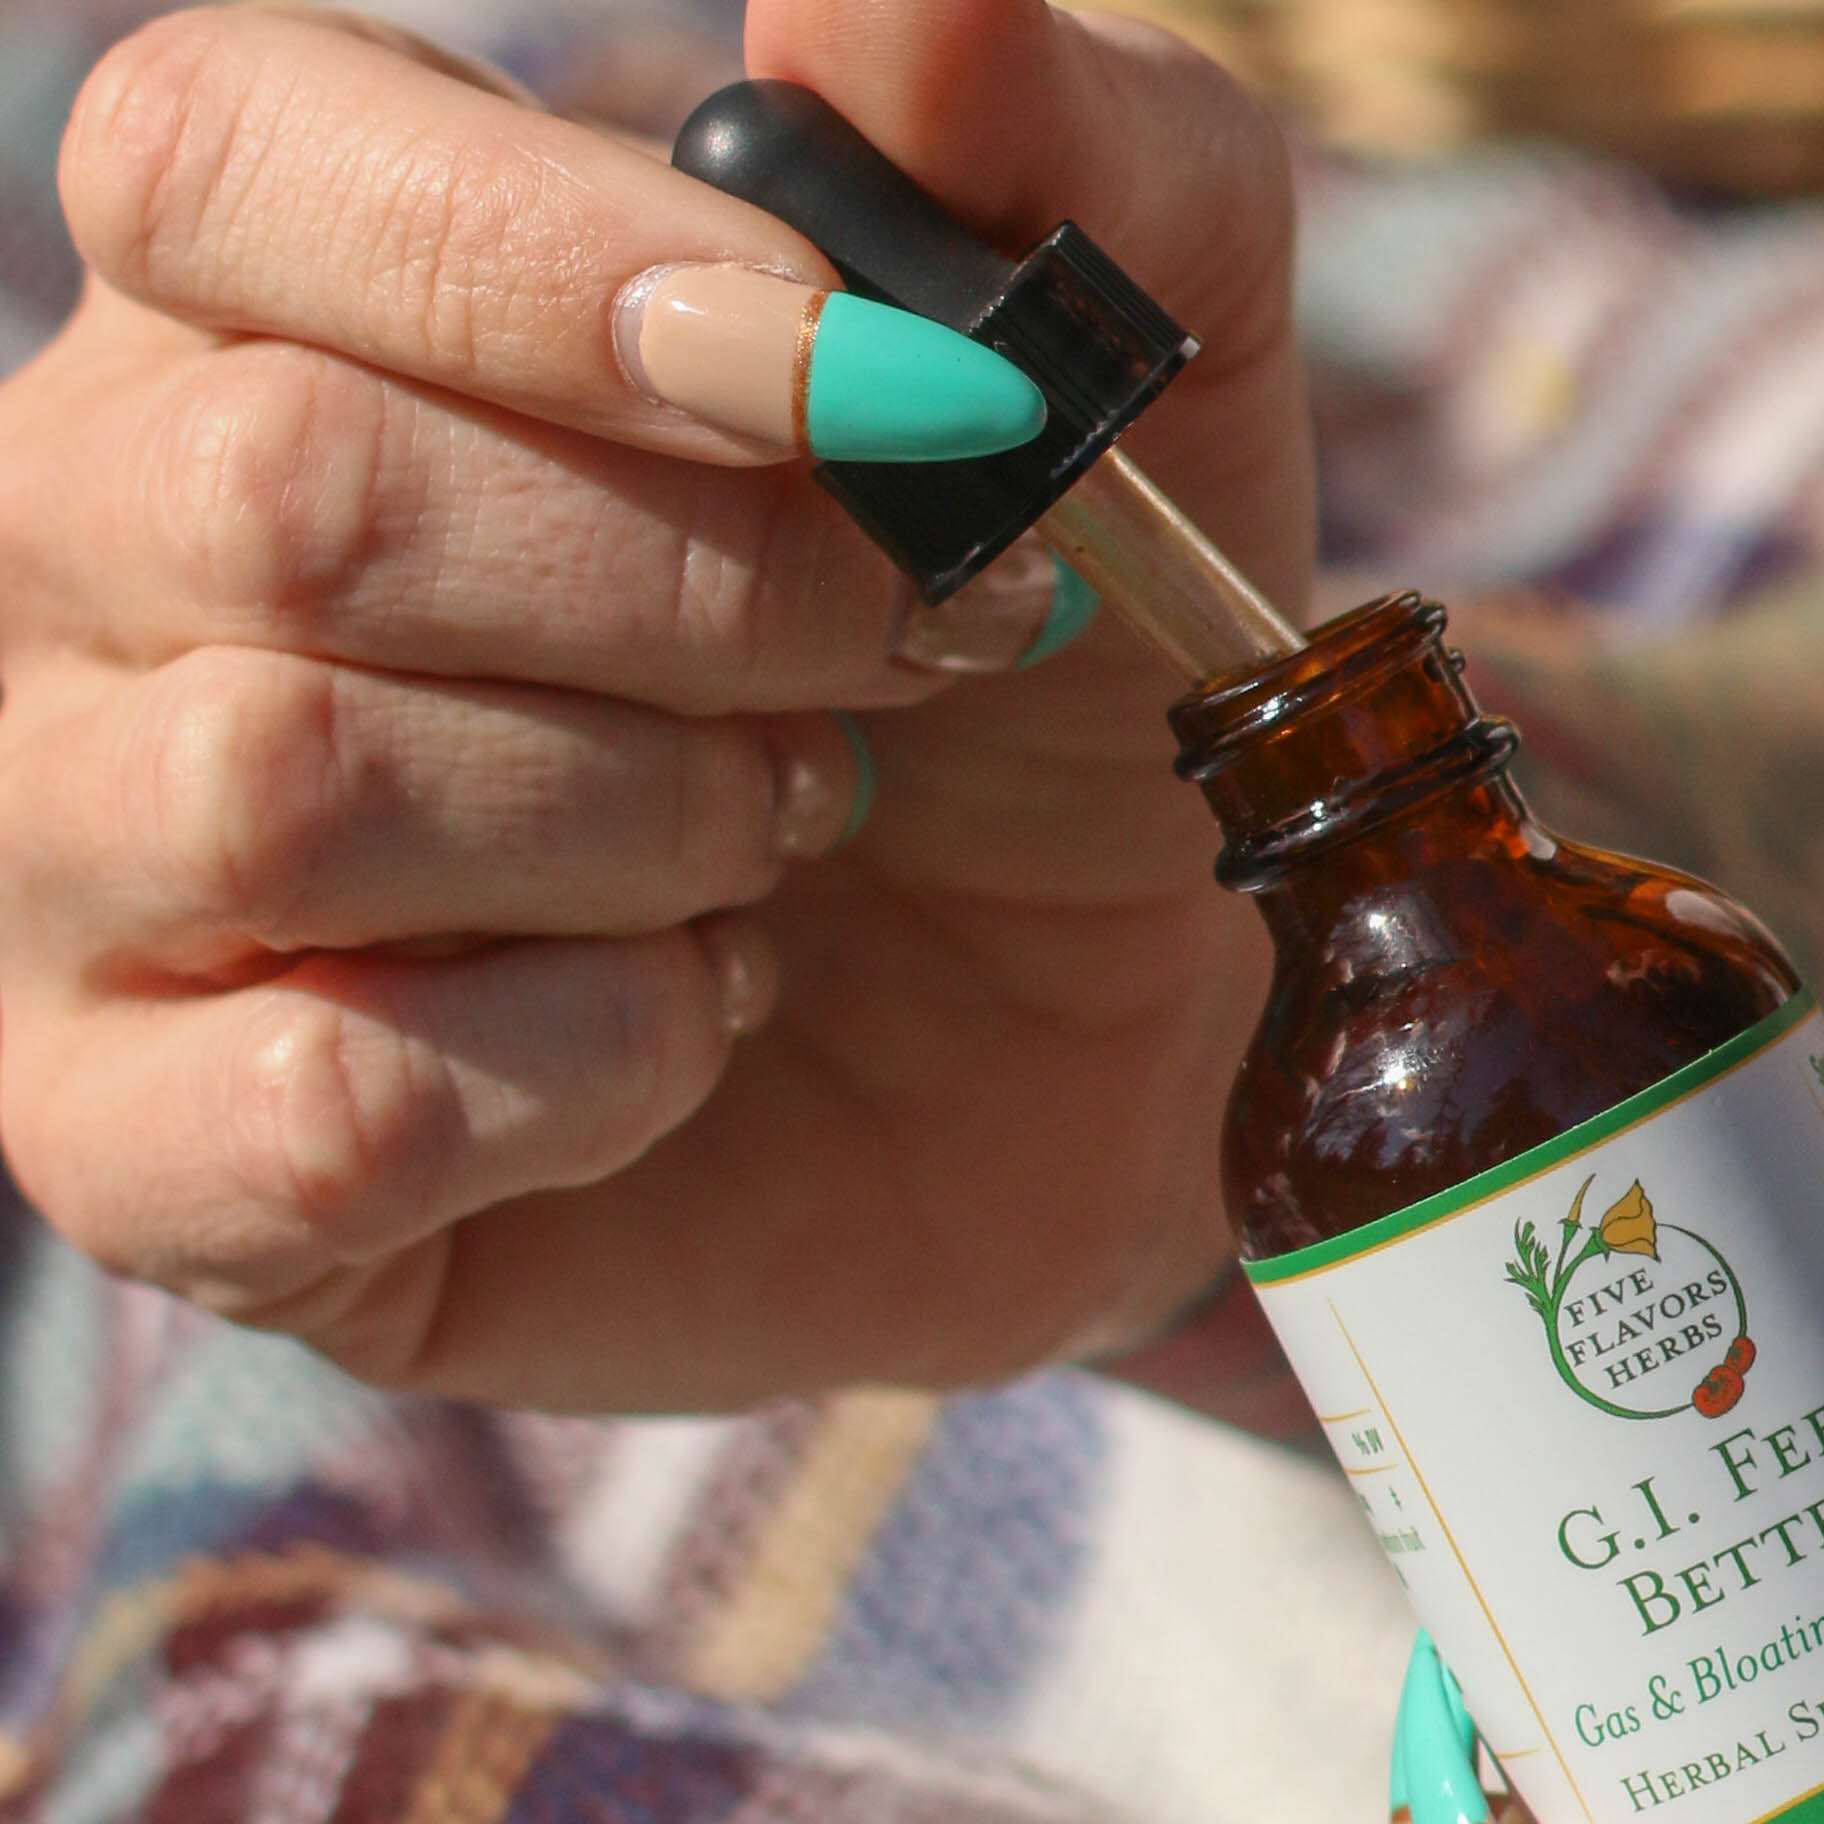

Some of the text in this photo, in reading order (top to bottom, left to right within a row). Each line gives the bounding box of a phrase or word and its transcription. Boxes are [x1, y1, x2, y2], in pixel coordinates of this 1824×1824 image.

[1563, 1267, 1655, 1327] FIVE
[1566, 1269, 1728, 1367] FLAVORS
[1604, 1313, 1723, 1389] HERBS
[1557, 1476, 1700, 1570] G.I.
[1574, 1703, 1641, 1747] Gas
[1648, 1675, 1686, 1721] &
